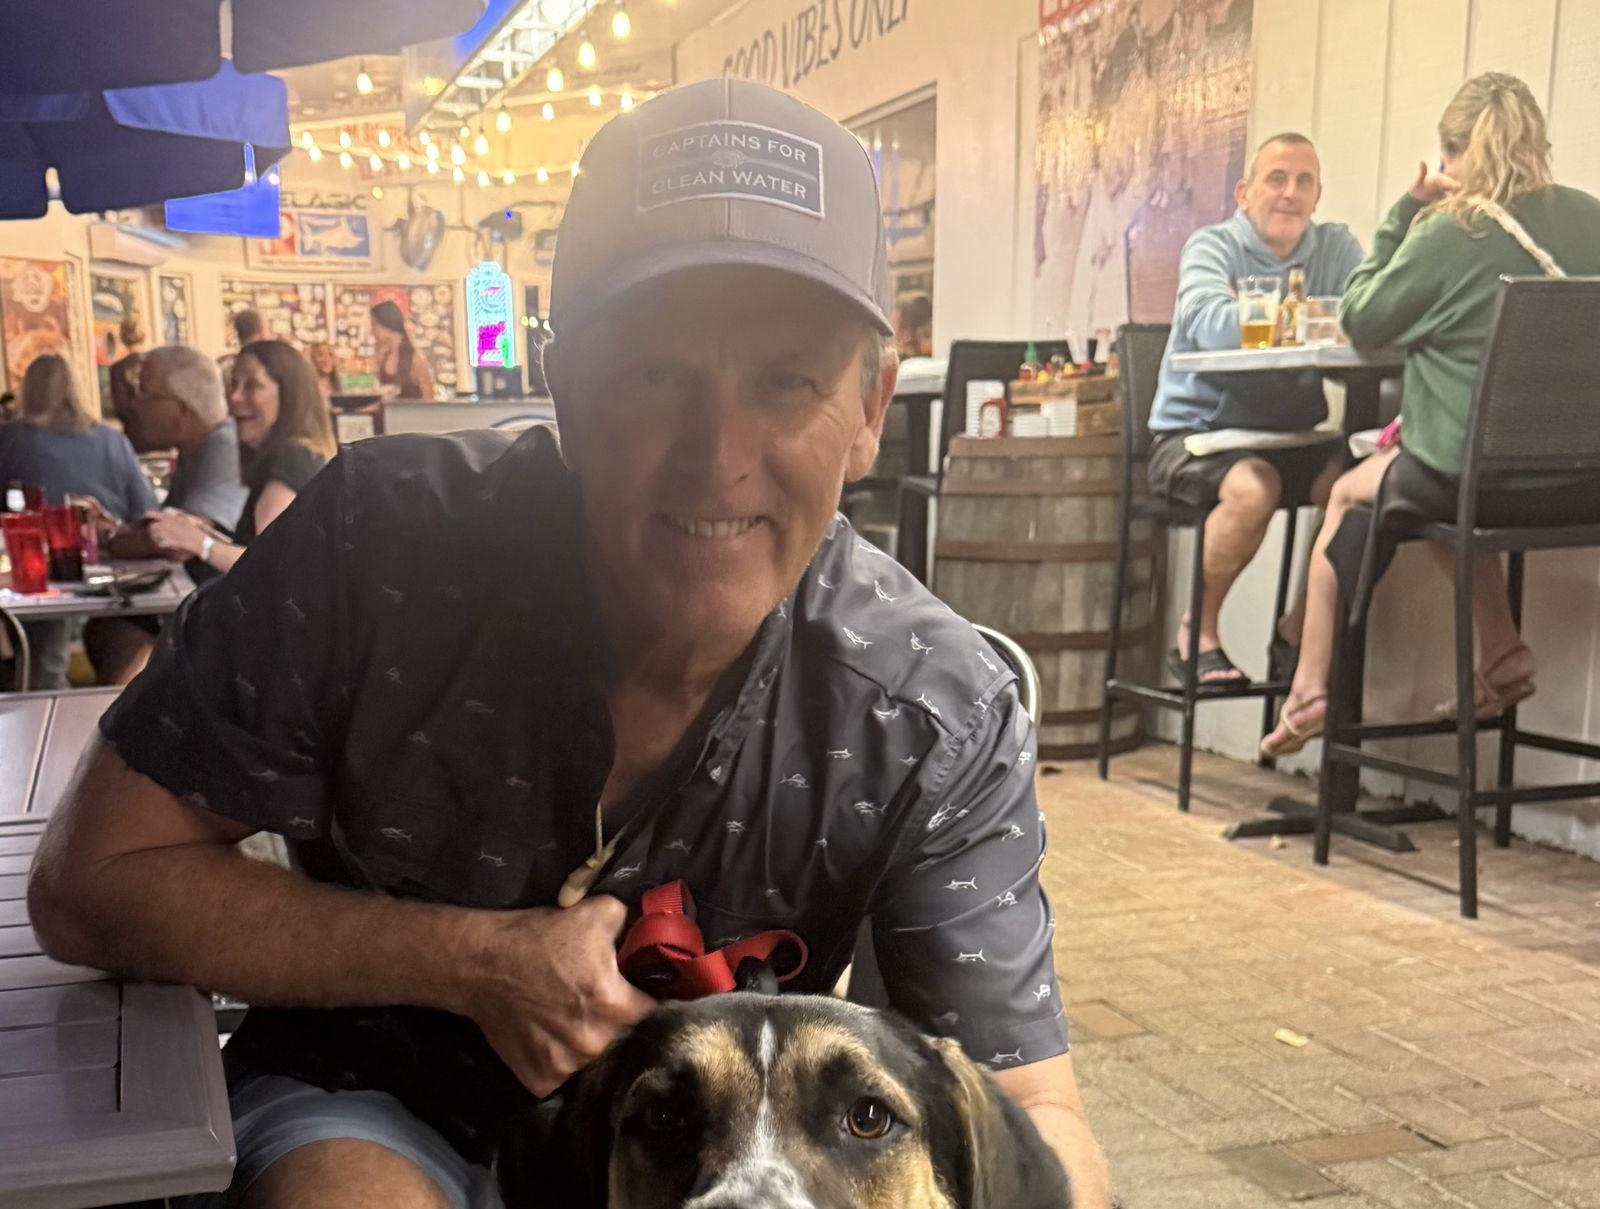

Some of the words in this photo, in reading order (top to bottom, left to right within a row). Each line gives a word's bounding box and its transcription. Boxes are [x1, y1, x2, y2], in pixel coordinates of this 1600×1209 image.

[782, 0, 842, 88] VIBES
[850, 0, 908, 48] ON
[652, 132, 760, 158] CAPTAINS
[767, 140, 807, 163] FOR
[652, 171, 724, 193] CLEAN
[732, 171, 807, 199] WATER
